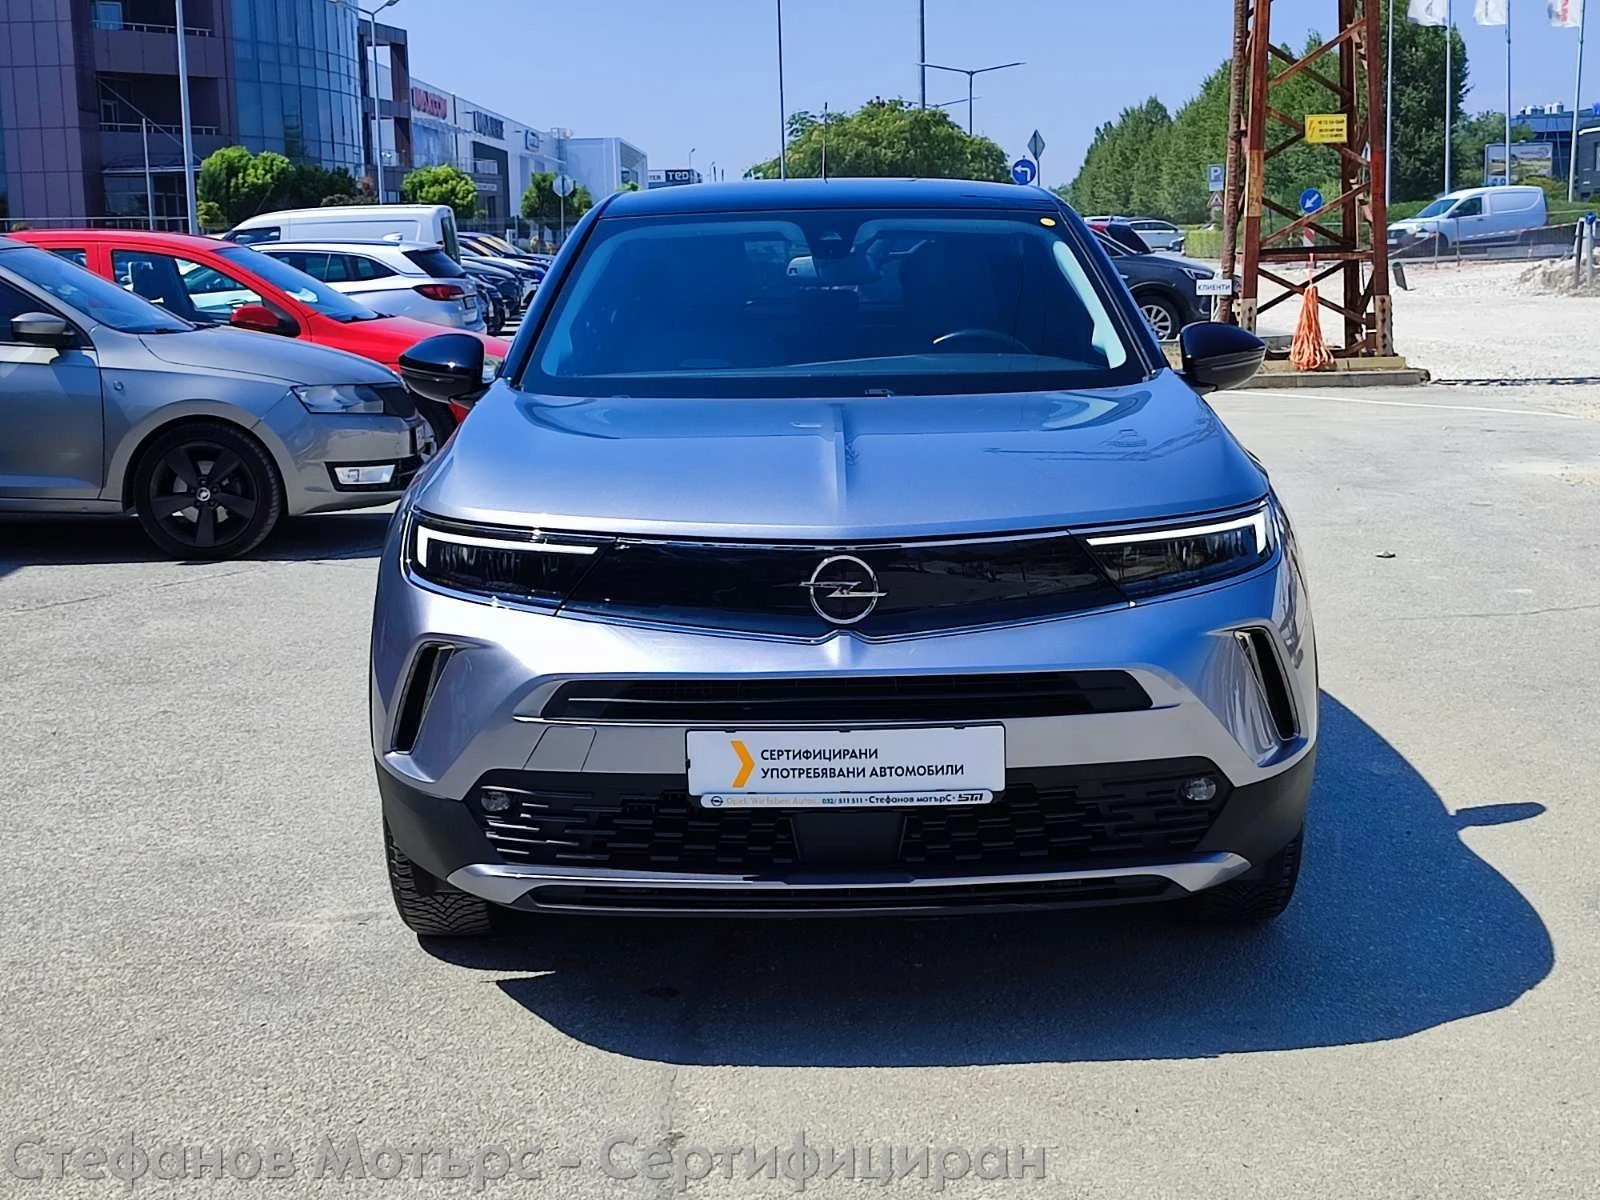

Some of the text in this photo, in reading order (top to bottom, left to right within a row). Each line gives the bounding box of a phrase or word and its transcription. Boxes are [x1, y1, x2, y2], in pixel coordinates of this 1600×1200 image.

[1197, 282, 1232, 291] КЛИЕНТИ
[760, 748, 879, 762] СЕРТИФИЦИРАНИ
[760, 763, 965, 780] УПОТРЕБЯВАНИ АВТОМОБИЛИ
